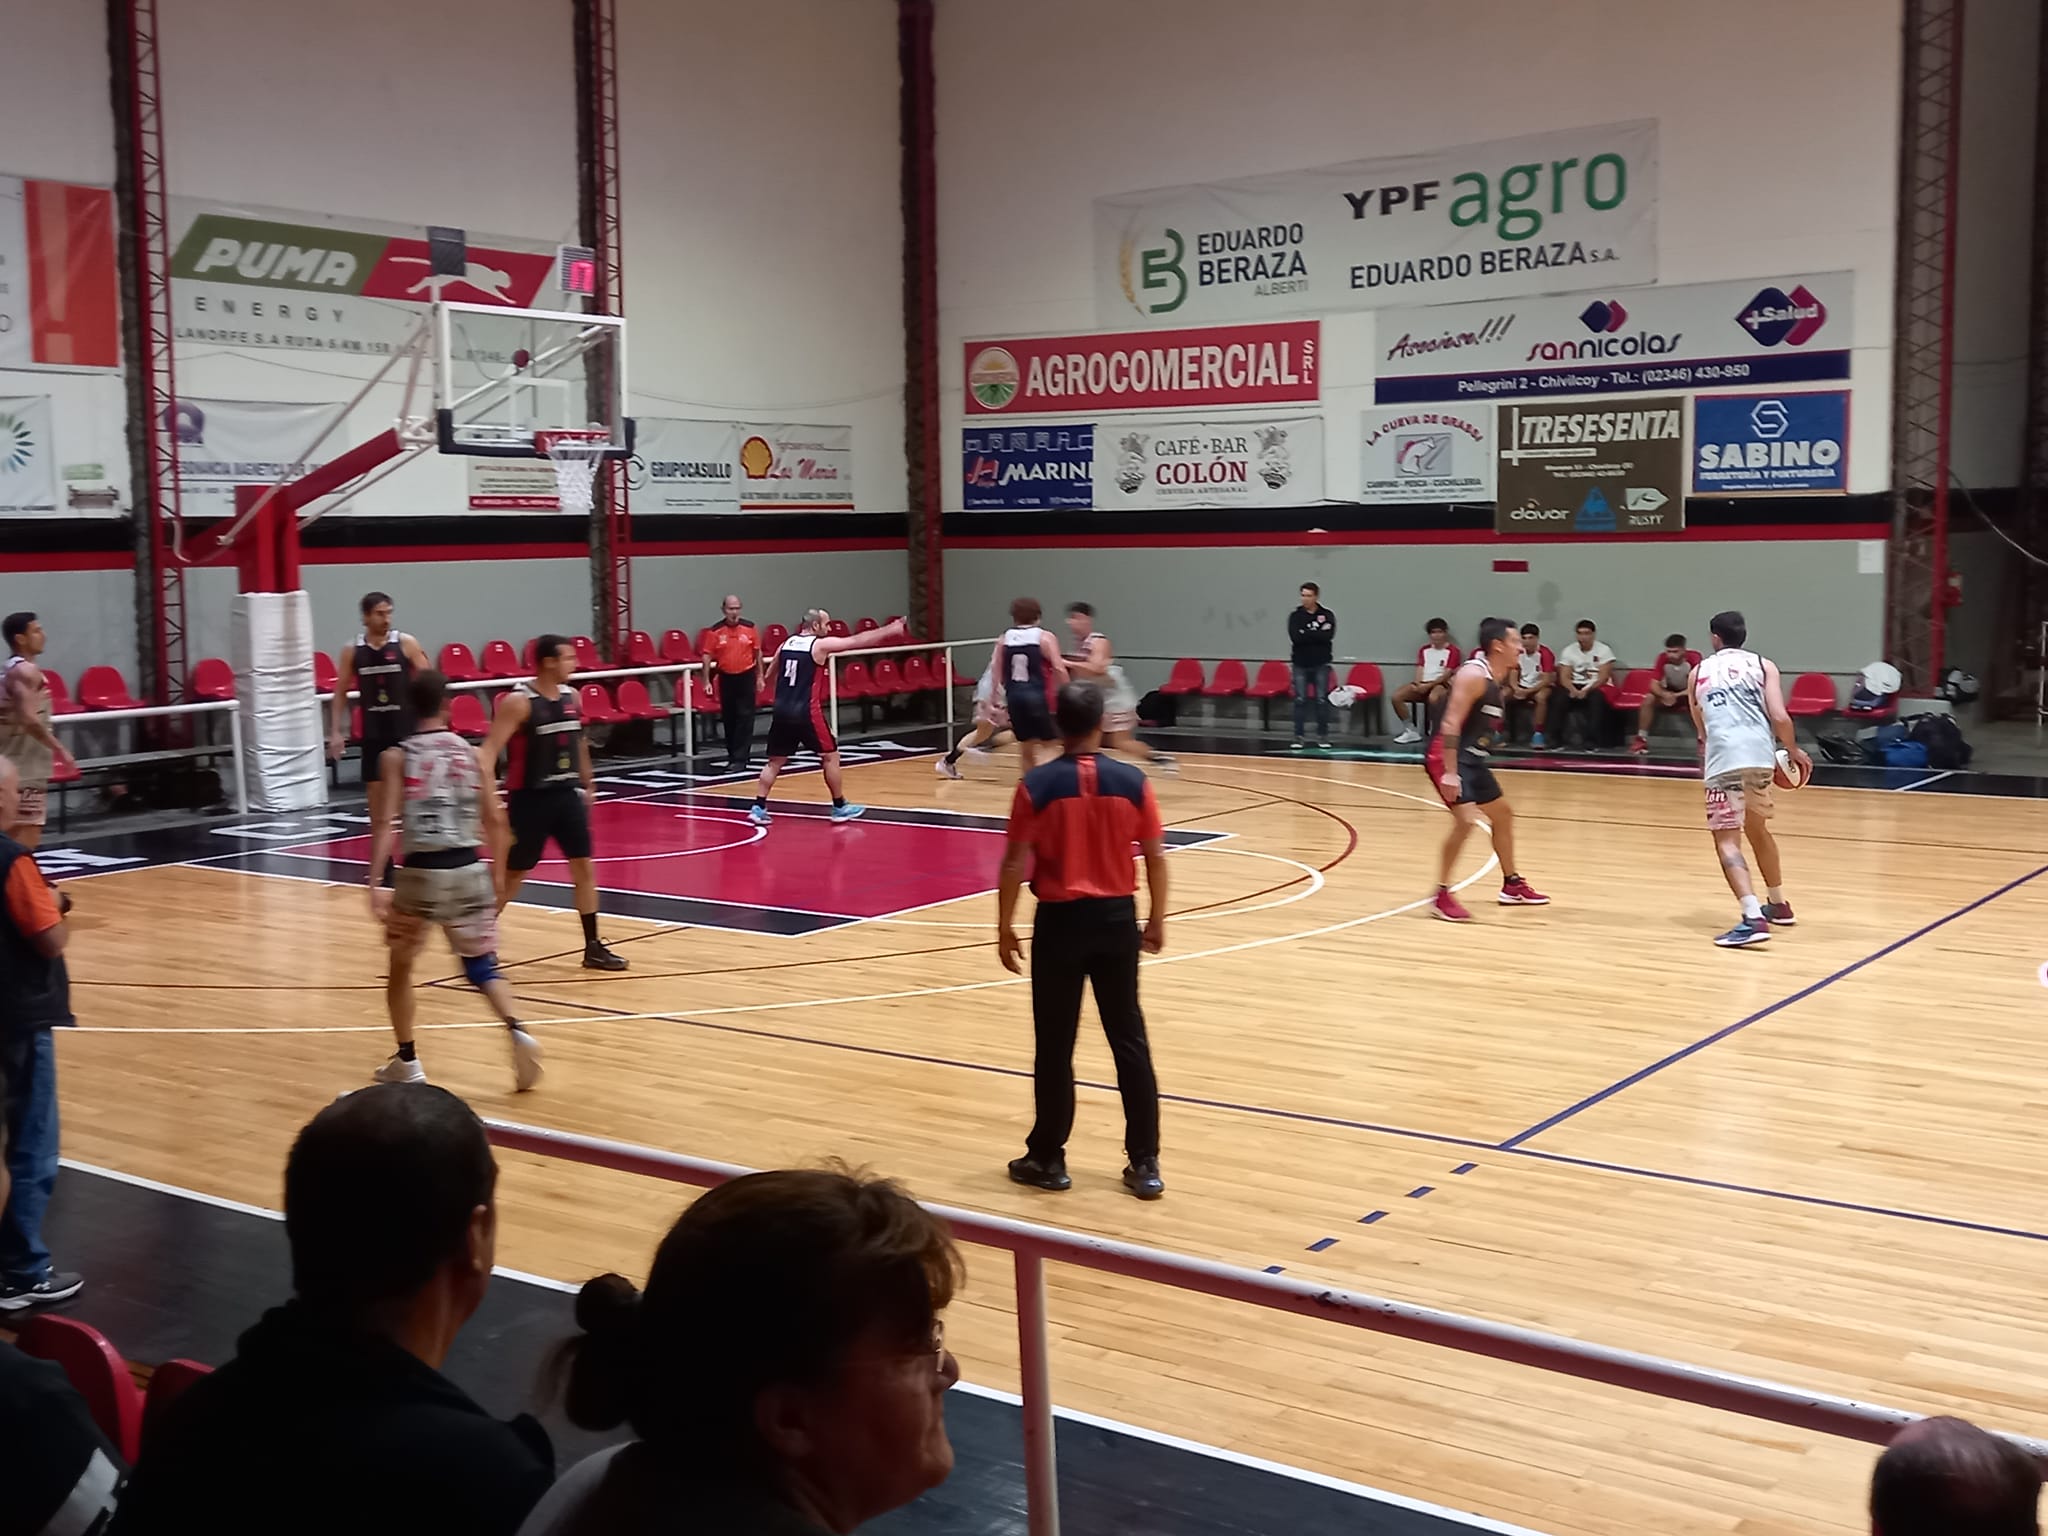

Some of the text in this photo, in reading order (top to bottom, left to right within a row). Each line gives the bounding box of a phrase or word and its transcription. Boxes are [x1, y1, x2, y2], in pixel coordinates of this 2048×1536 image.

[1342, 153, 1626, 241] YPF agro
[1197, 223, 1304, 255] EDUARDO
[193, 237, 358, 287] PUMA
[1199, 250, 1308, 286] BERAZA
[1350, 254, 1472, 289] EDUARDO
[1480, 242, 1588, 275] BERAZA
[1254, 279, 1309, 296] ALBERTI
[195, 296, 344, 322] ENERGY
[1026, 339, 1315, 397] AGROCOMERCIAL SRL
[1458, 377, 1518, 393] Pellegrini
[1519, 377, 1527, 389] 2
[1539, 373, 1600, 390] Chivilcoy
[1642, 368, 1692, 385] (02346)
[1521, 410, 1680, 444] TRESESENTA
[1155, 436, 1200, 456] CAFÉ
[1211, 437, 1248, 454] BAR
[1699, 440, 1841, 469] SABINO
[1156, 456, 1248, 485] COLÓN
[784, 659, 798, 687] 4
